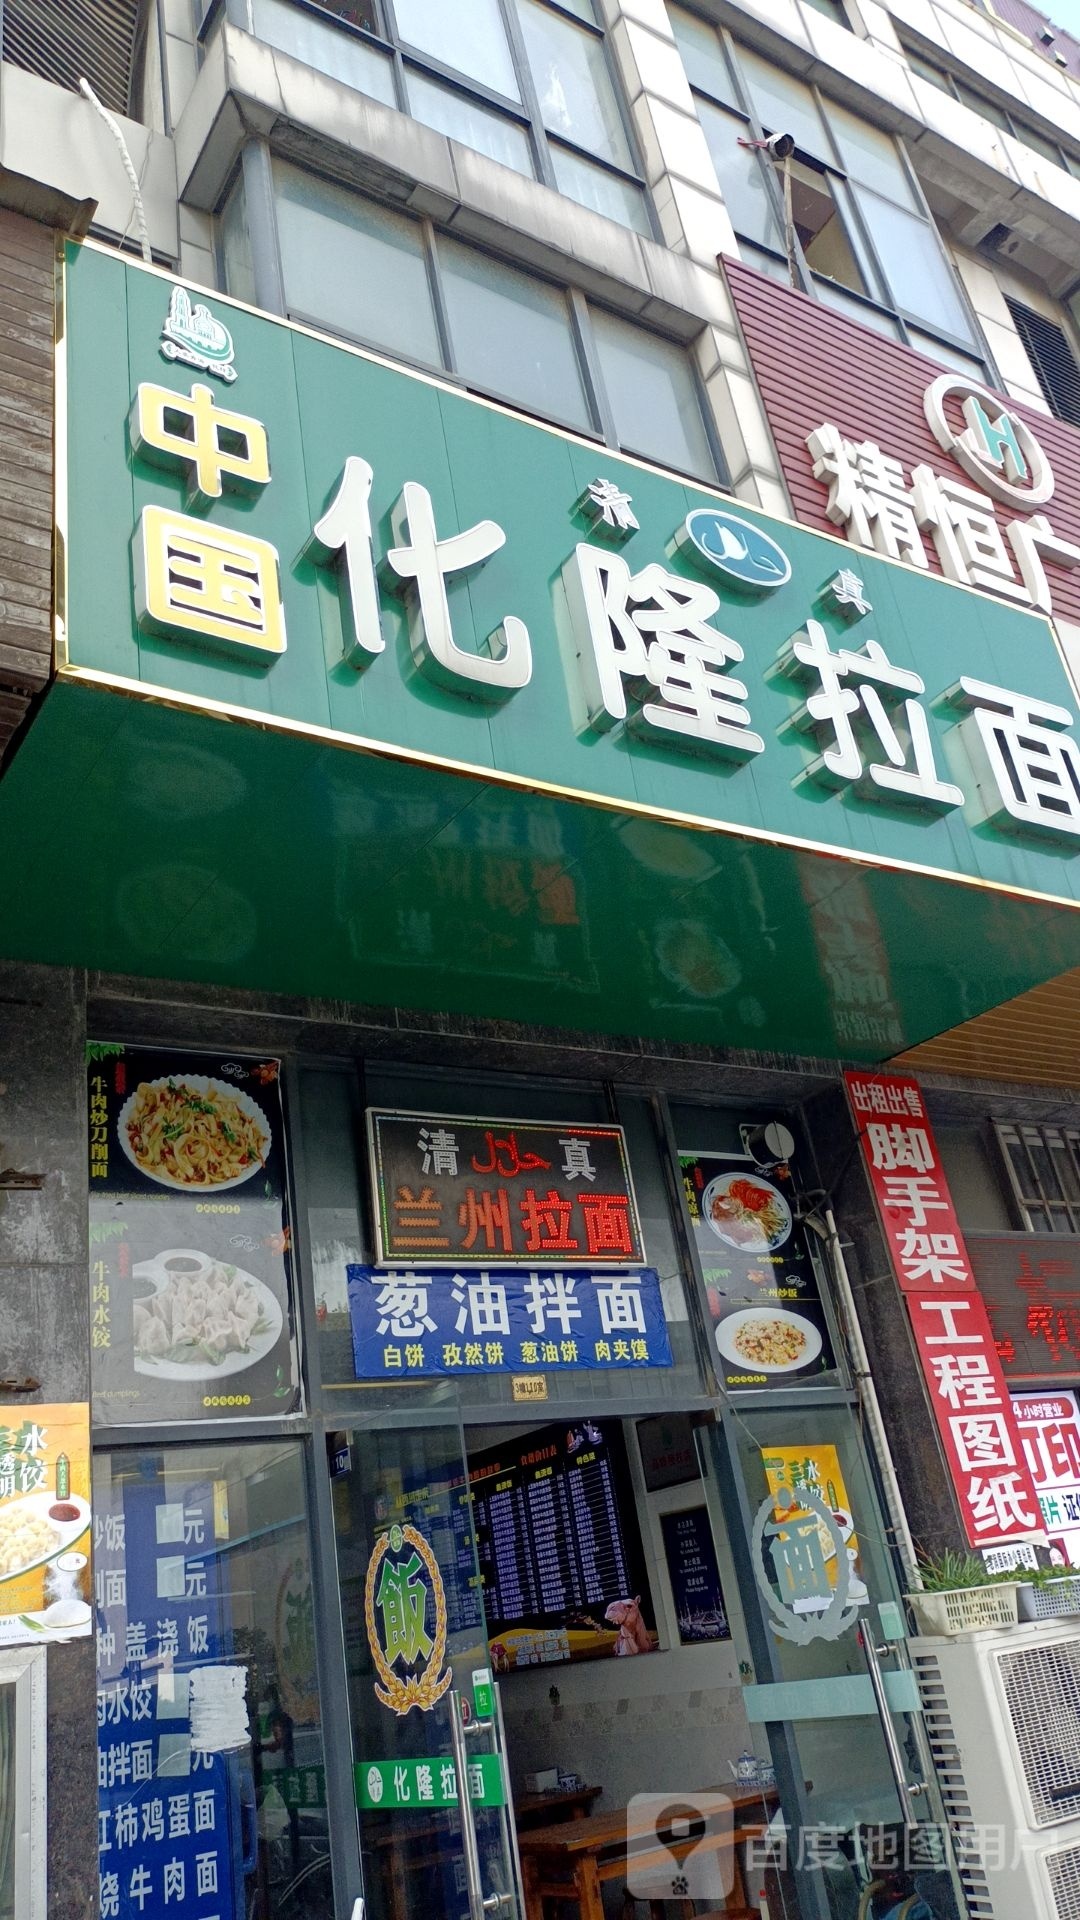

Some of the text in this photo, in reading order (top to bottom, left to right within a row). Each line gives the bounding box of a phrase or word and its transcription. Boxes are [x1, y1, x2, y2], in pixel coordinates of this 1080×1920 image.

[136, 383, 287, 653] 中国
[313, 455, 1080, 836] 化隆拉面
[90, 1076, 108, 1178] 牛肉炒刀削面
[850, 1080, 923, 1118] 出租出售
[416, 1128, 460, 1176] 清
[558, 1137, 597, 1182] 真
[392, 1185, 634, 1254] 兰州拉面
[866, 1122, 969, 1284] 脚手架
[91, 1261, 111, 1349] 牛肉水饺
[371, 1271, 648, 1338] 葱油拌面
[383, 1338, 650, 1368] 白饼 孜然饼 葱油饼 肉夹馍
[919, 1301, 1036, 1532] 工程图纸
[20, 1424, 48, 1491] 水饺
[184, 1508, 205, 1545] 元
[186, 1560, 207, 1598] 元
[393, 1763, 486, 1802] 化隆拉面
